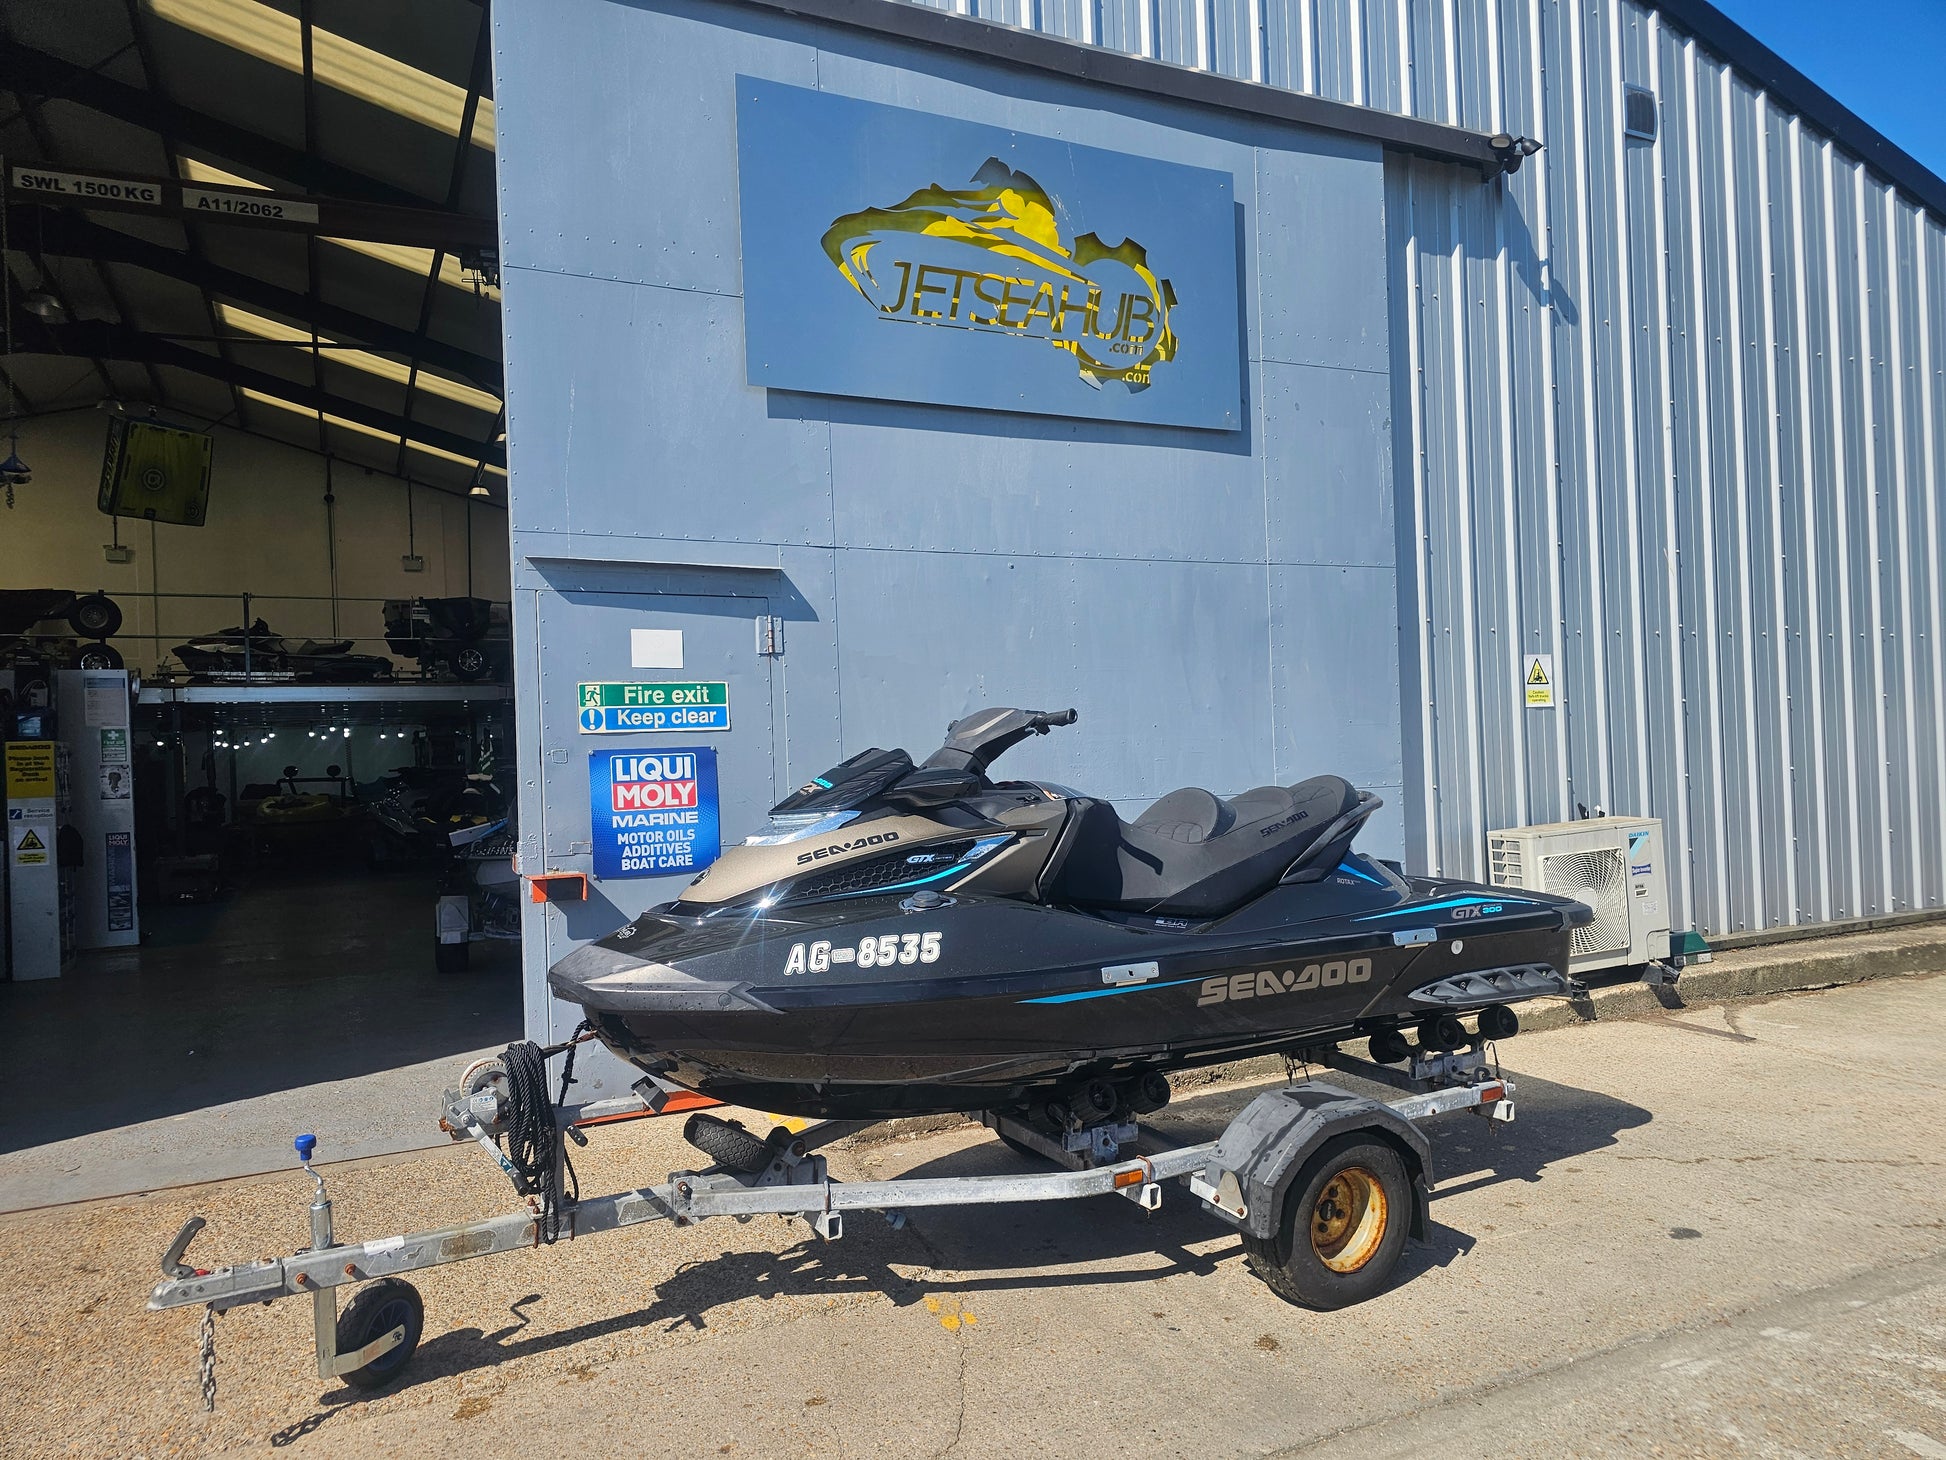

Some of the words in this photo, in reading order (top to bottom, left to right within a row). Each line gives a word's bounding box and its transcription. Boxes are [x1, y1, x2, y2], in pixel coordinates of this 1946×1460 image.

[21, 174, 65, 191] SWL
[73, 181, 121, 197] 1500
[124, 185, 155, 201] KG
[198, 197, 284, 218] A11/2062
[880, 260, 1155, 342] JETSEAHUB
[1108, 342, 1144, 356] .com
[624, 686, 665, 704] Fire
[671, 686, 709, 704] exit
[617, 709, 666, 728] Keep
[671, 708, 717, 724] clear
[616, 756, 692, 781] LIQUI
[617, 782, 695, 808] MOLY
[612, 811, 699, 828] MARINE
[617, 831, 664, 845] MOTOR
[666, 829, 695, 843] OILS
[622, 842, 691, 858] ADDITIVES
[907, 854, 936, 863] GTX
[621, 857, 656, 871] BOAT
[658, 854, 693, 868] CARE
[1452, 905, 1482, 919] GTX
[1482, 906, 1503, 914] 300
[784, 931, 943, 976] AG-8535
